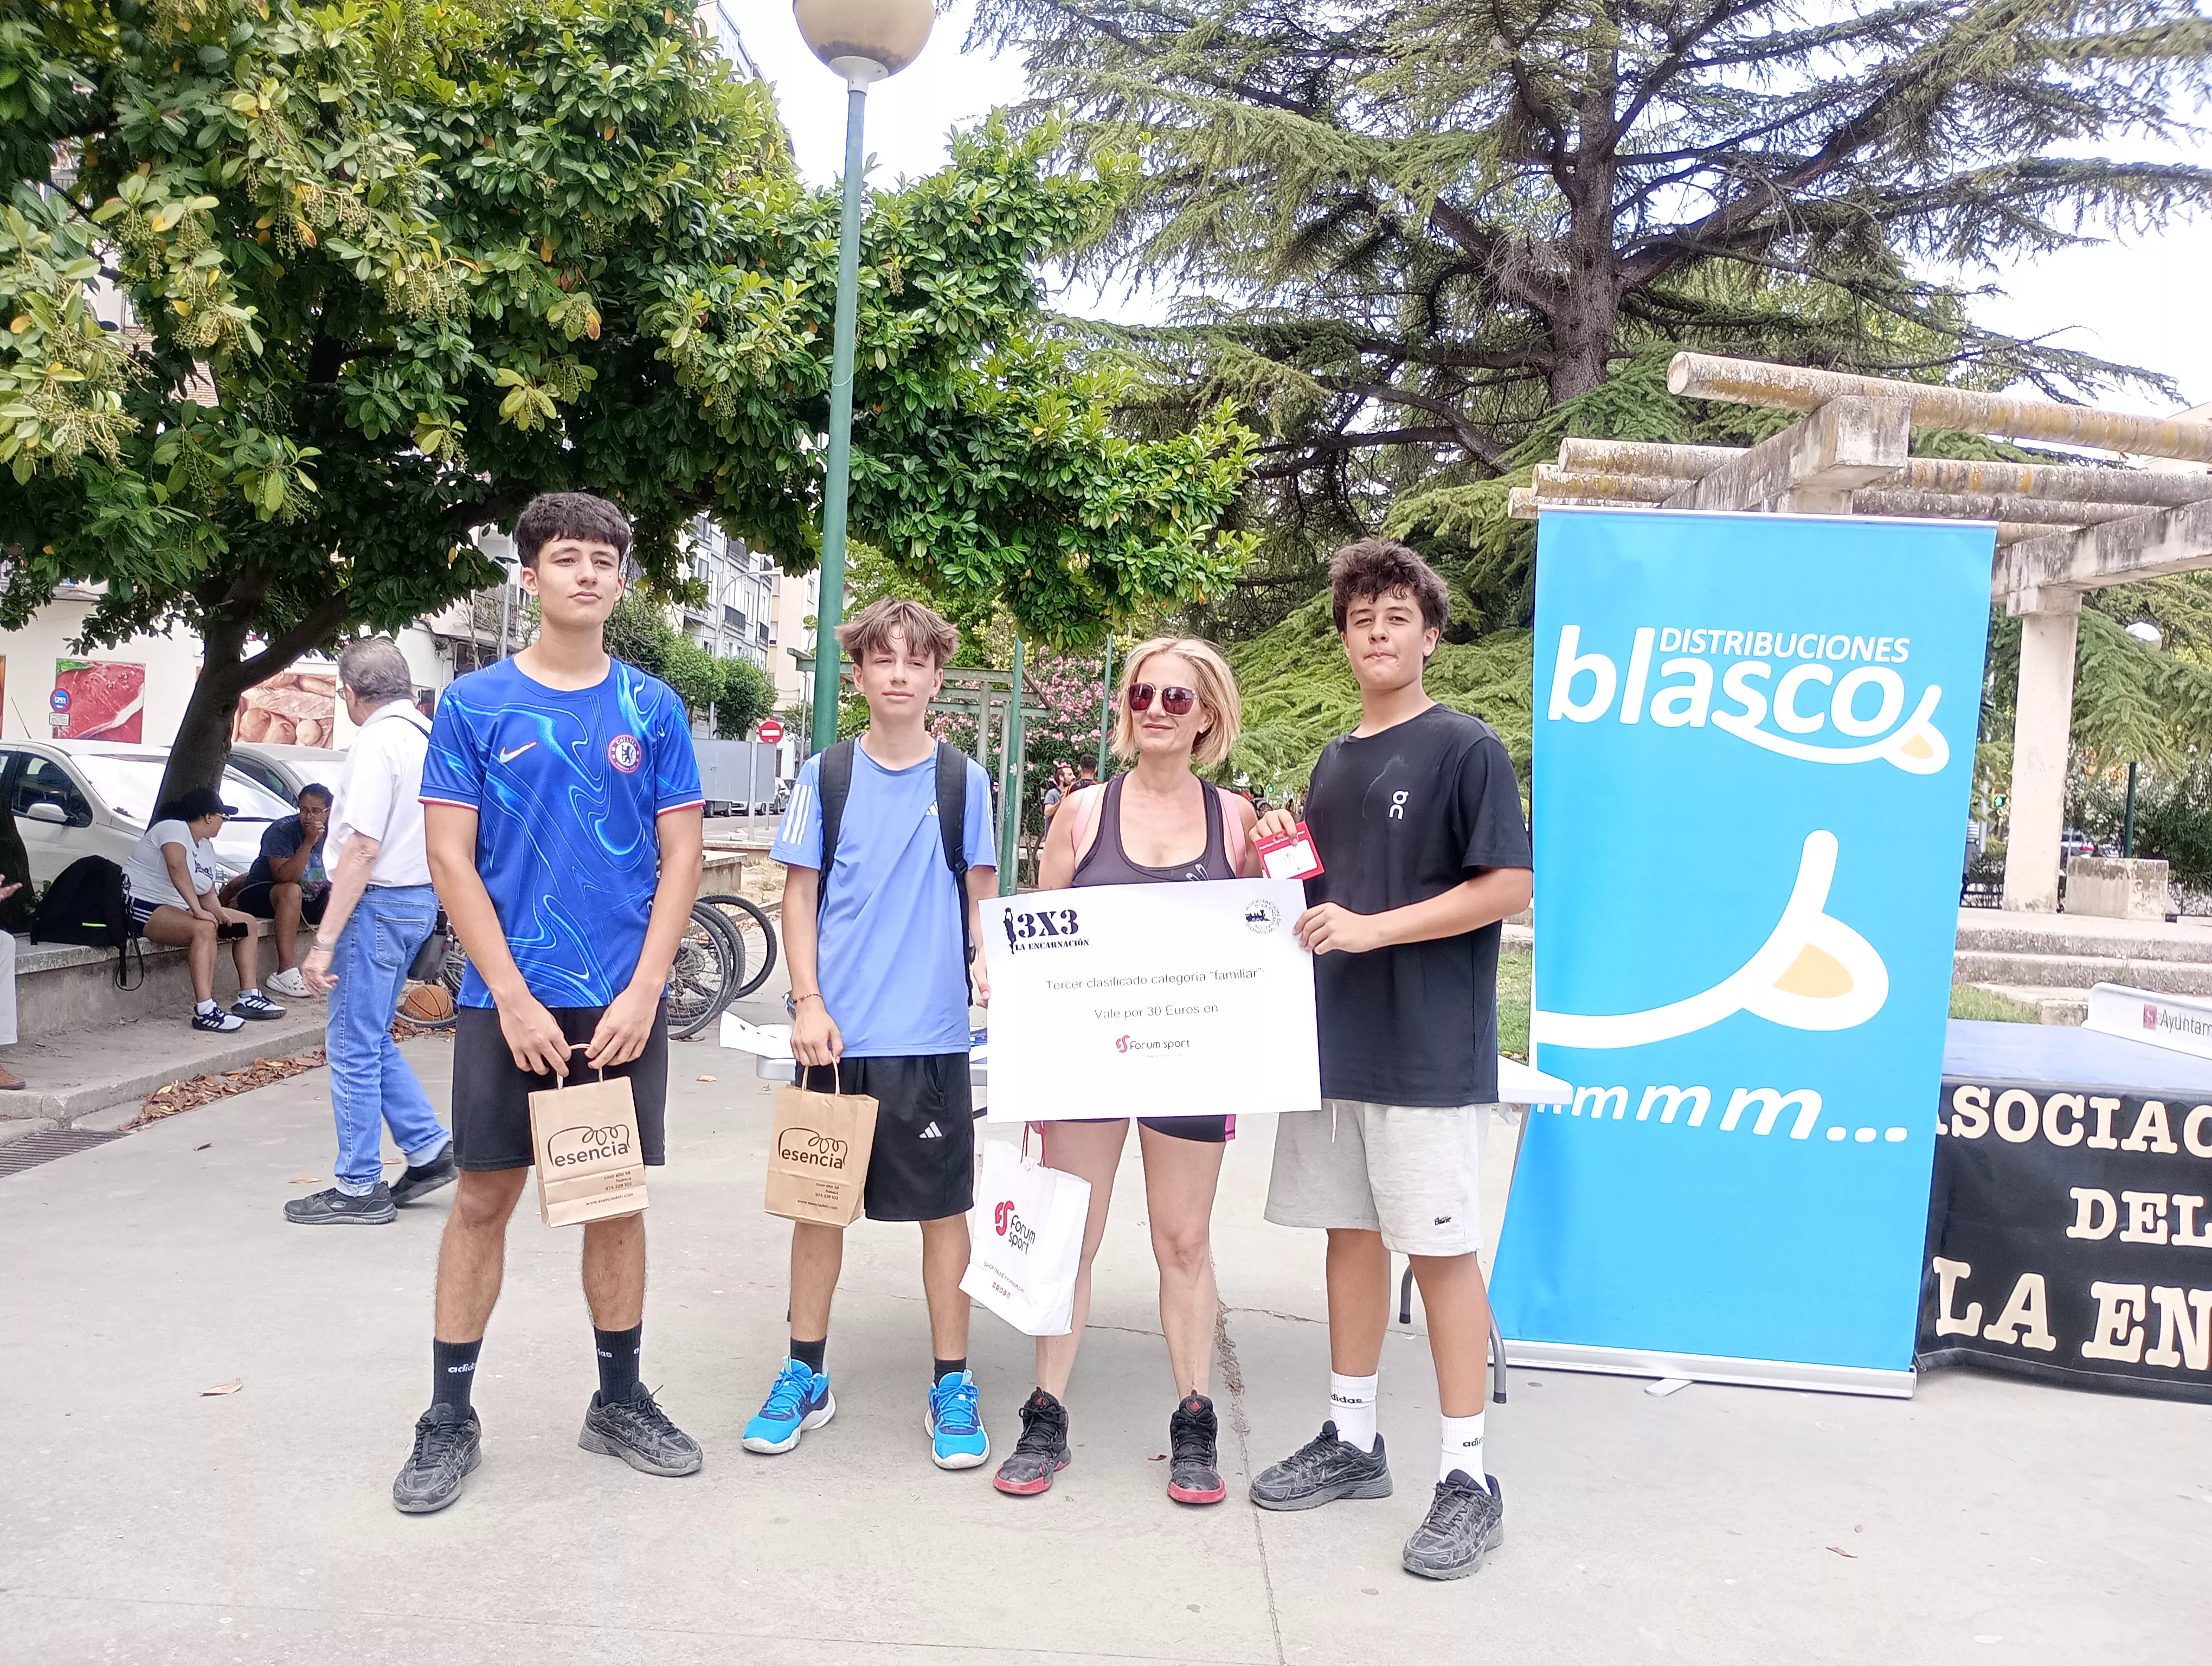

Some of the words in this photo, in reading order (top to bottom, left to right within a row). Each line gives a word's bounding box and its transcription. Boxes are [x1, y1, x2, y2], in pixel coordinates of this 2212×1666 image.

[1659, 627, 1909, 663] DISTRIBUCIONES
[1547, 624, 1905, 739] blasco
[1017, 909, 1079, 938] 3X3
[1028, 938, 1089, 951] ENCARNACIÓN
[1045, 980, 1083, 991] Tercer
[1086, 975, 1147, 989] clasificado
[1094, 1009, 1121, 1020] Vale
[1124, 1009, 1143, 1020] por
[1147, 1006, 1161, 1017] 30
[1165, 1004, 1200, 1016] Euros
[1204, 1003, 1218, 1014] en
[1163, 1040, 1190, 1049] sport
[1935, 1085, 2212, 1158] SOCIAC
[555, 1141, 628, 1167] esencia
[781, 1148, 843, 1170] esencia
[2065, 1187, 2212, 1248] DEL
[1008, 1231, 1029, 1255] sport
[1932, 1256, 2057, 1352] LA
[2080, 1280, 2212, 1371] EN
[448, 1362, 476, 1373] adid
[1330, 1393, 1363, 1404] didas
[1462, 1436, 1484, 1447] adid
